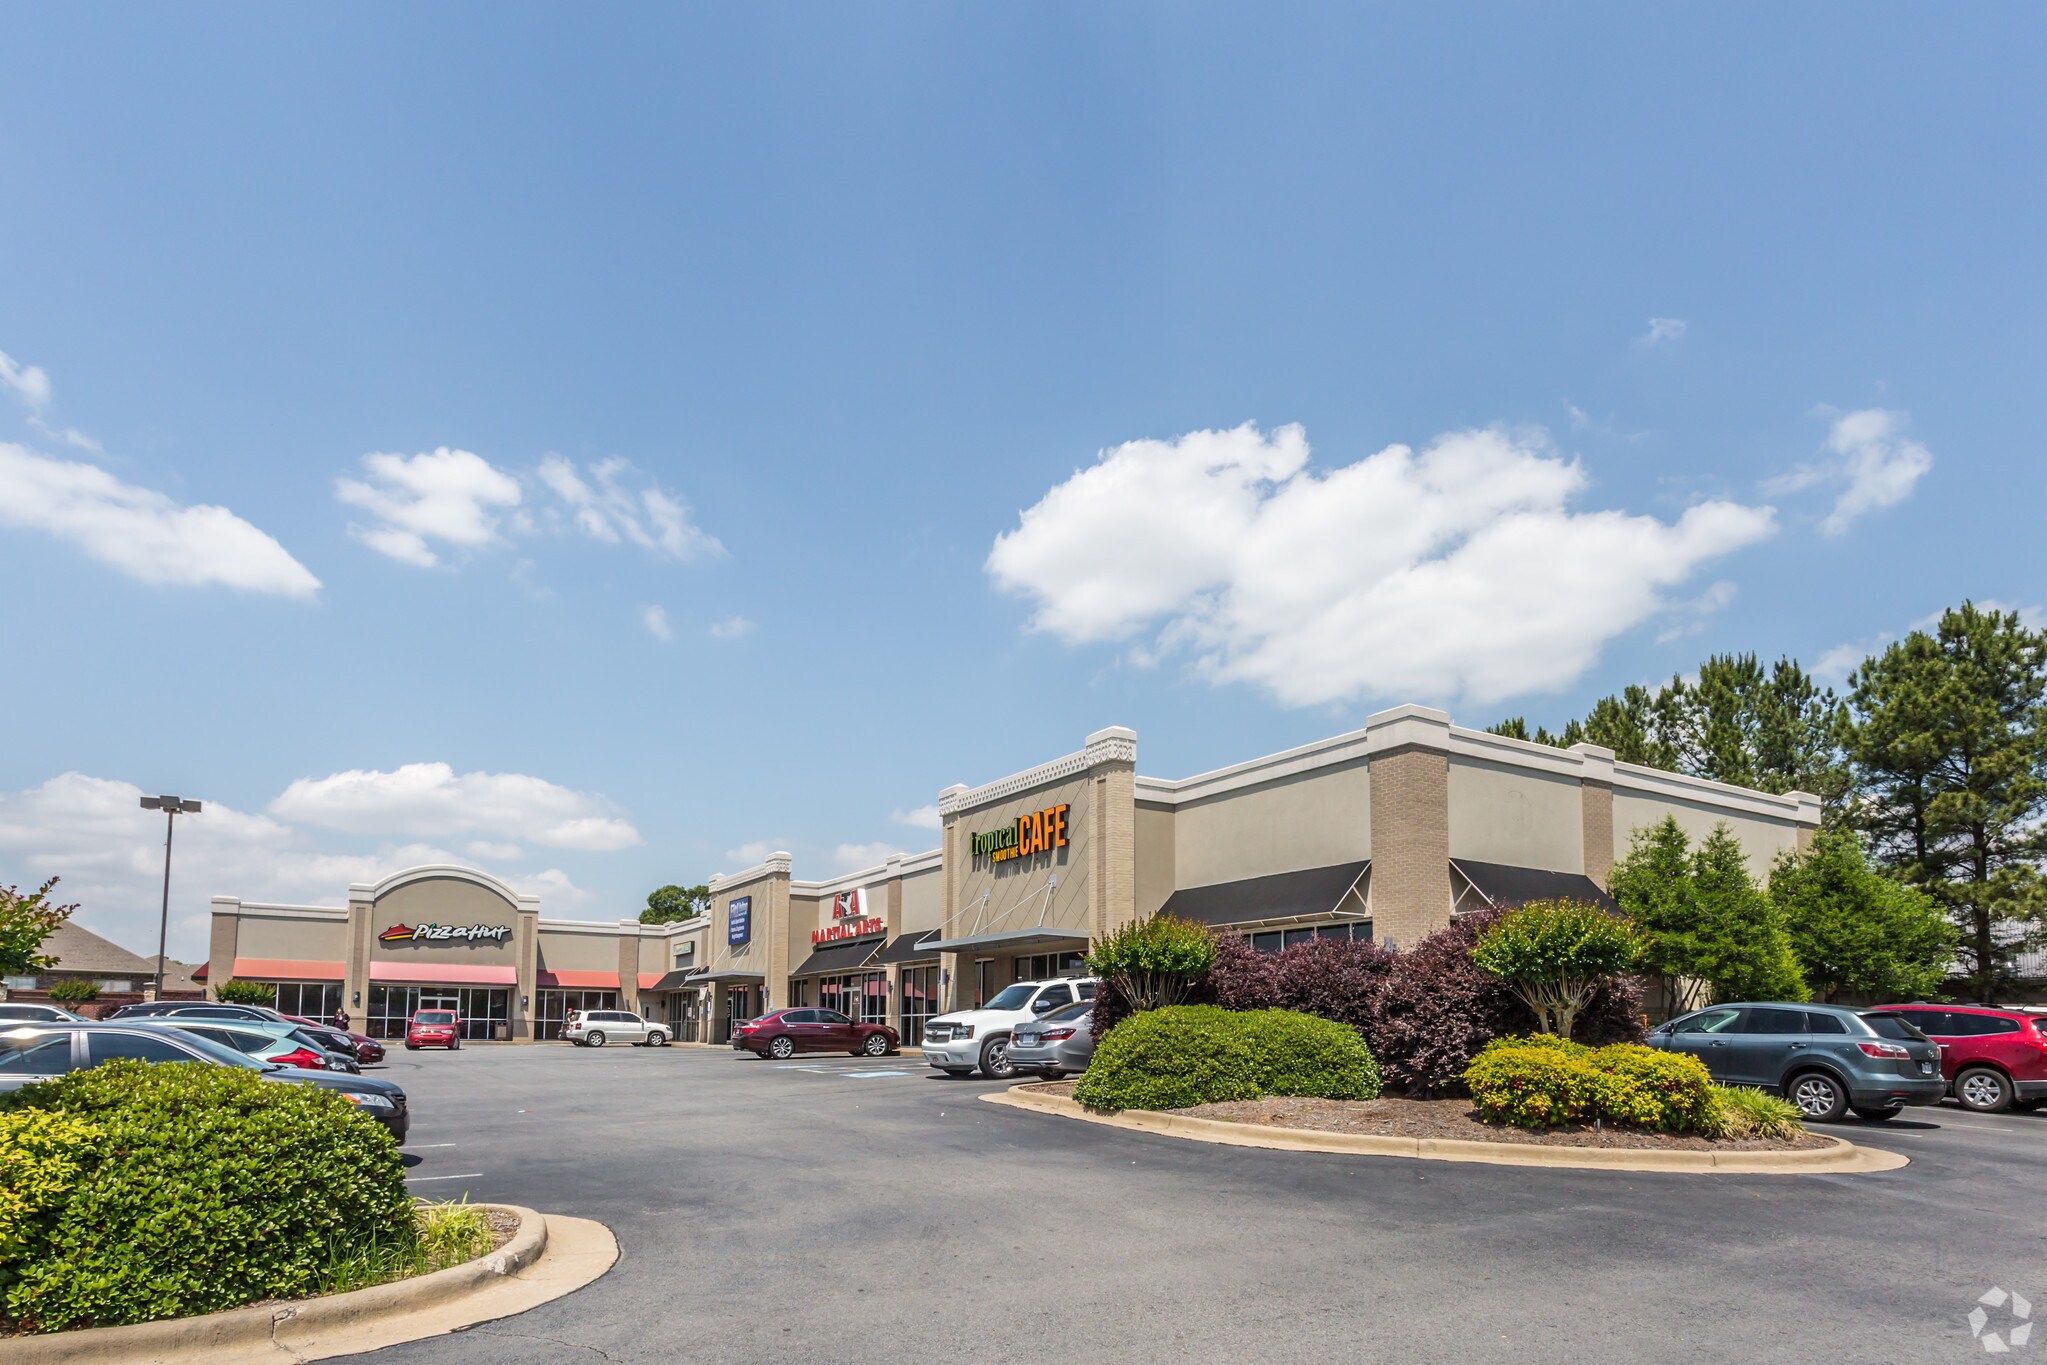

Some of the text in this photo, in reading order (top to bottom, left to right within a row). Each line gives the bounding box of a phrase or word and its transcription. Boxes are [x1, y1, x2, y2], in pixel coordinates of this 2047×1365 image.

[969, 817, 1019, 857] tropical
[1019, 803, 1068, 856] CAFE
[992, 845, 1019, 863] SMOOTHIE
[811, 917, 881, 944] MARTIAL ARTS
